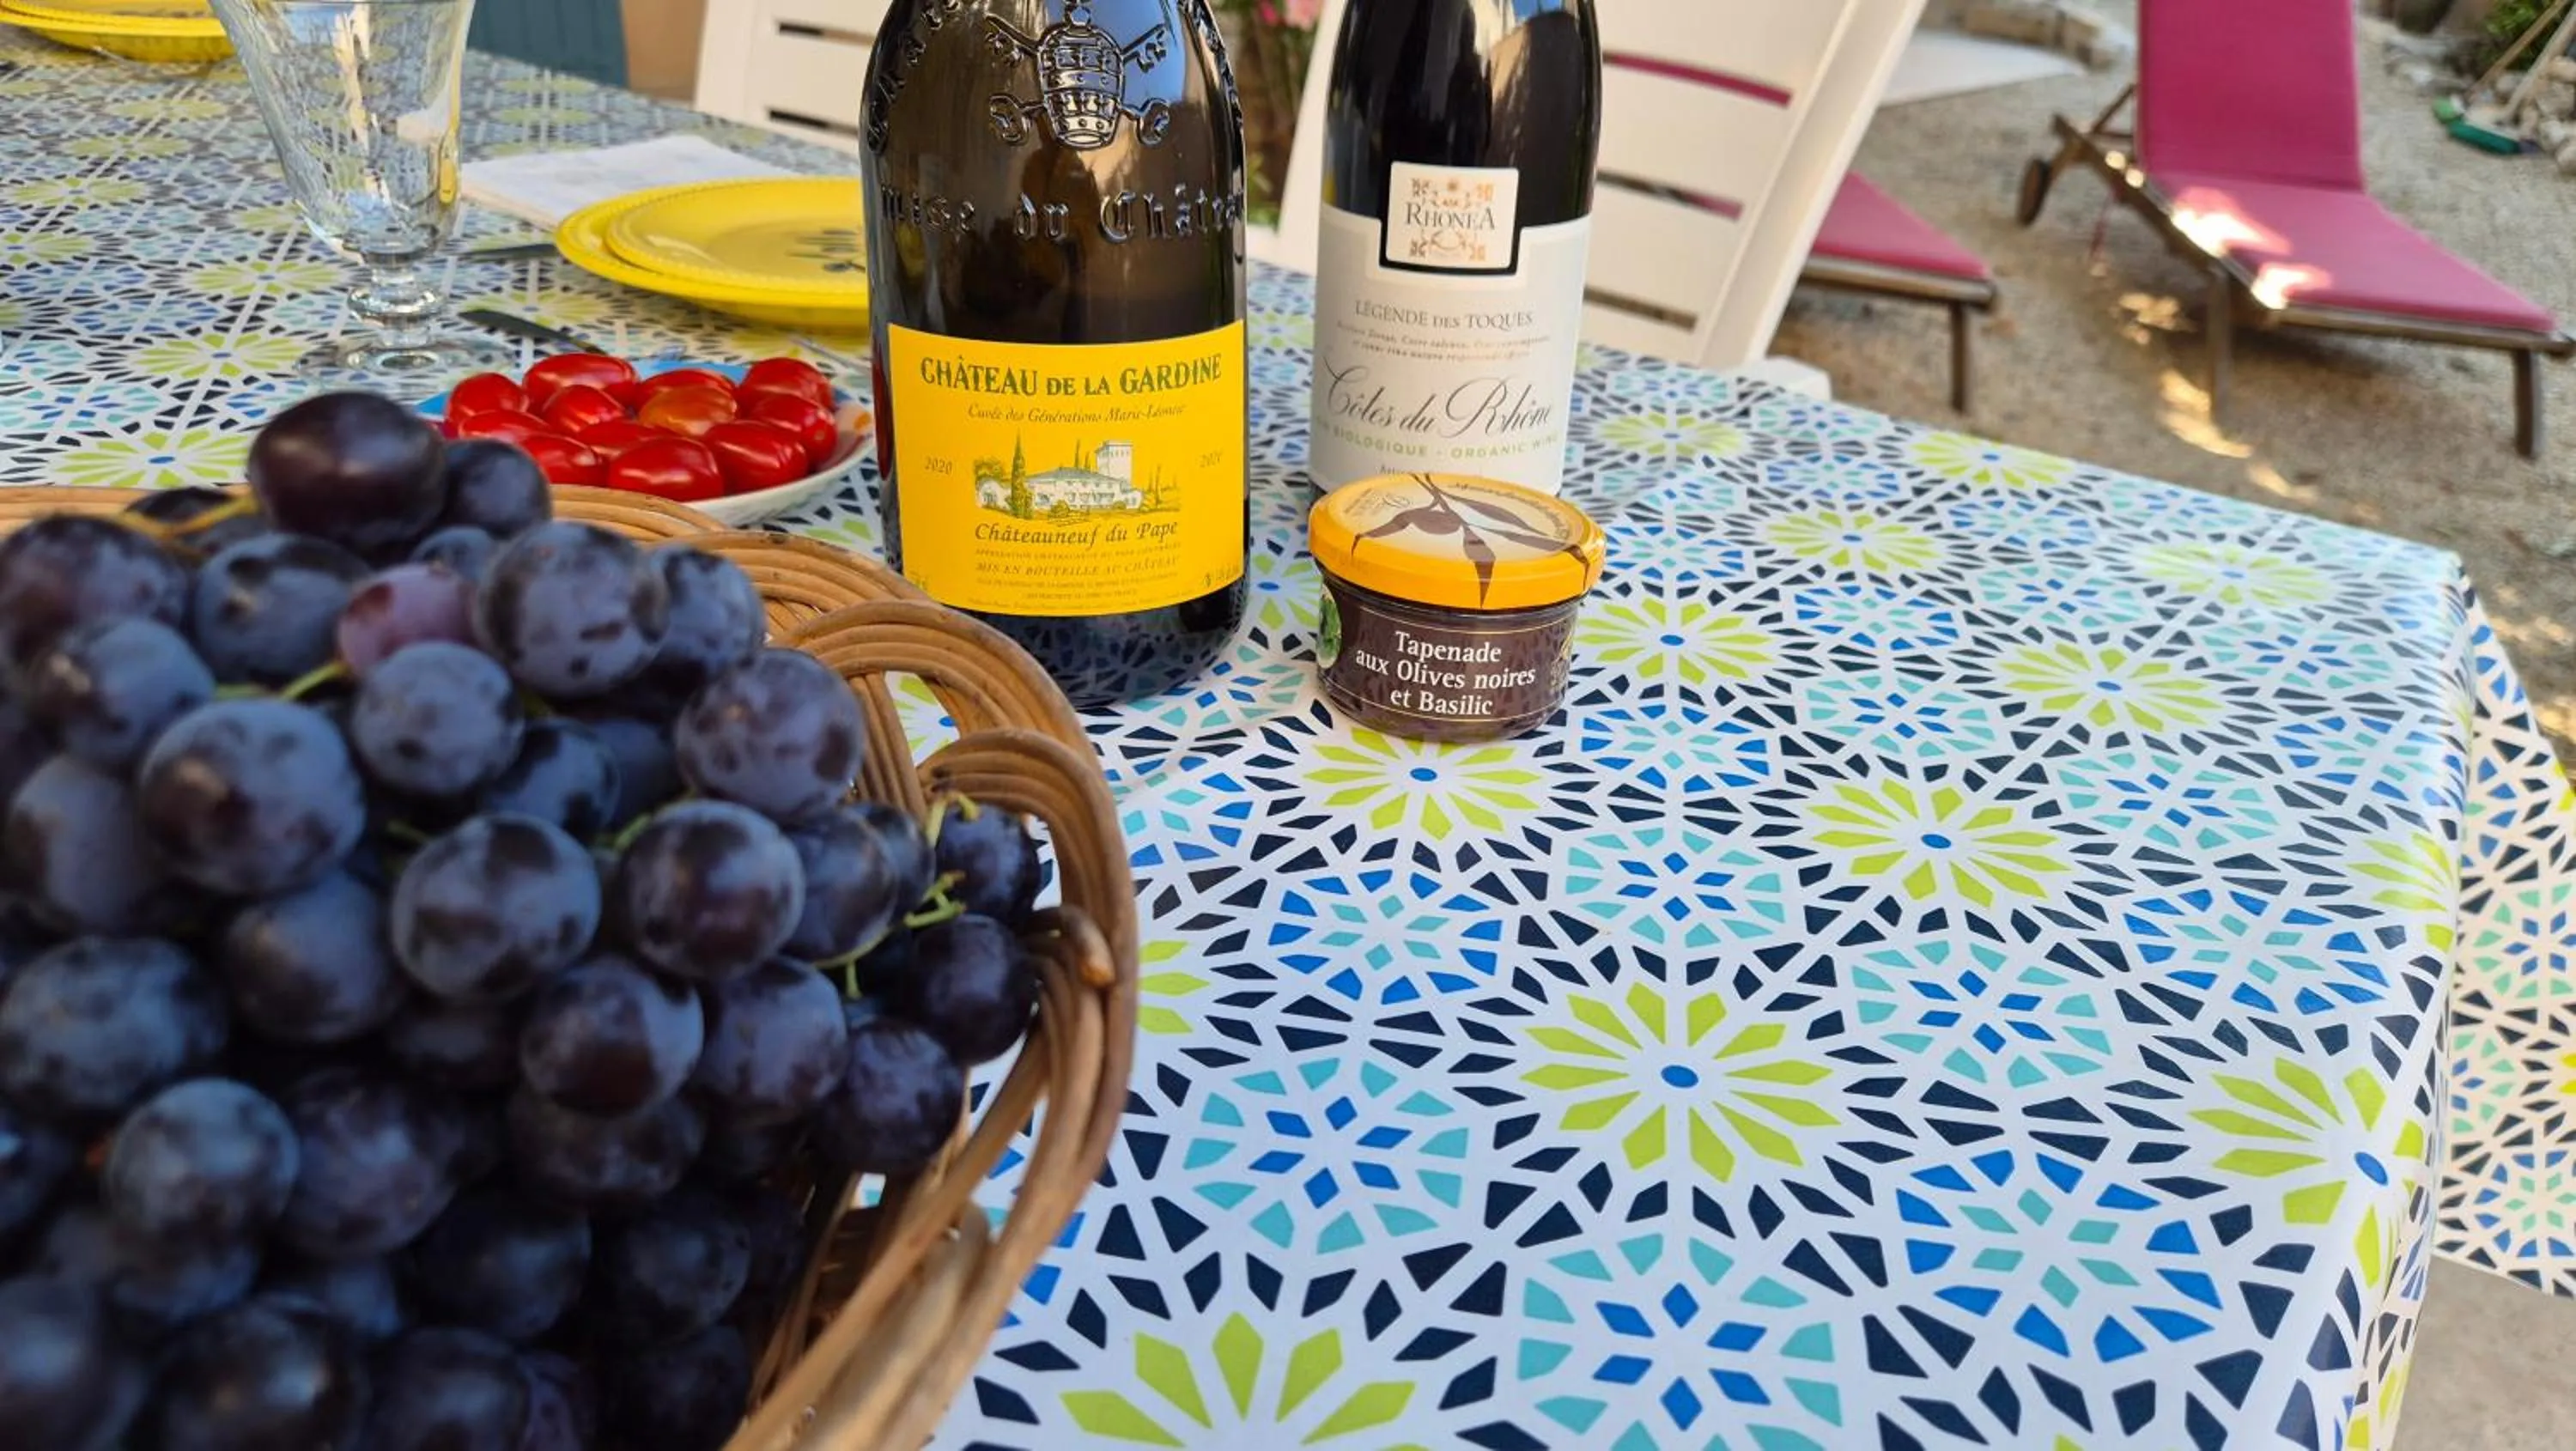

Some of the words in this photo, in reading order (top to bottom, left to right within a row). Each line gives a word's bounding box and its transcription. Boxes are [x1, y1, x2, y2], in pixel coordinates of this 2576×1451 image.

[1465, 311, 1534, 331] TOQUES
[920, 355, 1037, 397] CHÂTEAU
[1047, 377, 1076, 396] DE
[1084, 376, 1110, 396] LA
[1119, 353, 1222, 395] GARDINE
[1322, 356, 1394, 428] Côtes
[1399, 393, 1437, 432] du
[1333, 424, 1427, 456] BIOLOGIQUE
[1451, 441, 1526, 458] ORGANIC
[975, 521, 1100, 550] Châteauneuf
[1105, 524, 1127, 542] du
[1137, 521, 1177, 543] Pape
[1395, 629, 1502, 663] Tapenade
[1356, 650, 1389, 676] aux
[1398, 659, 1465, 689] Olives
[1474, 668, 1535, 689] noires
[1391, 688, 1412, 708] et
[1419, 693, 1493, 715] Basilic
